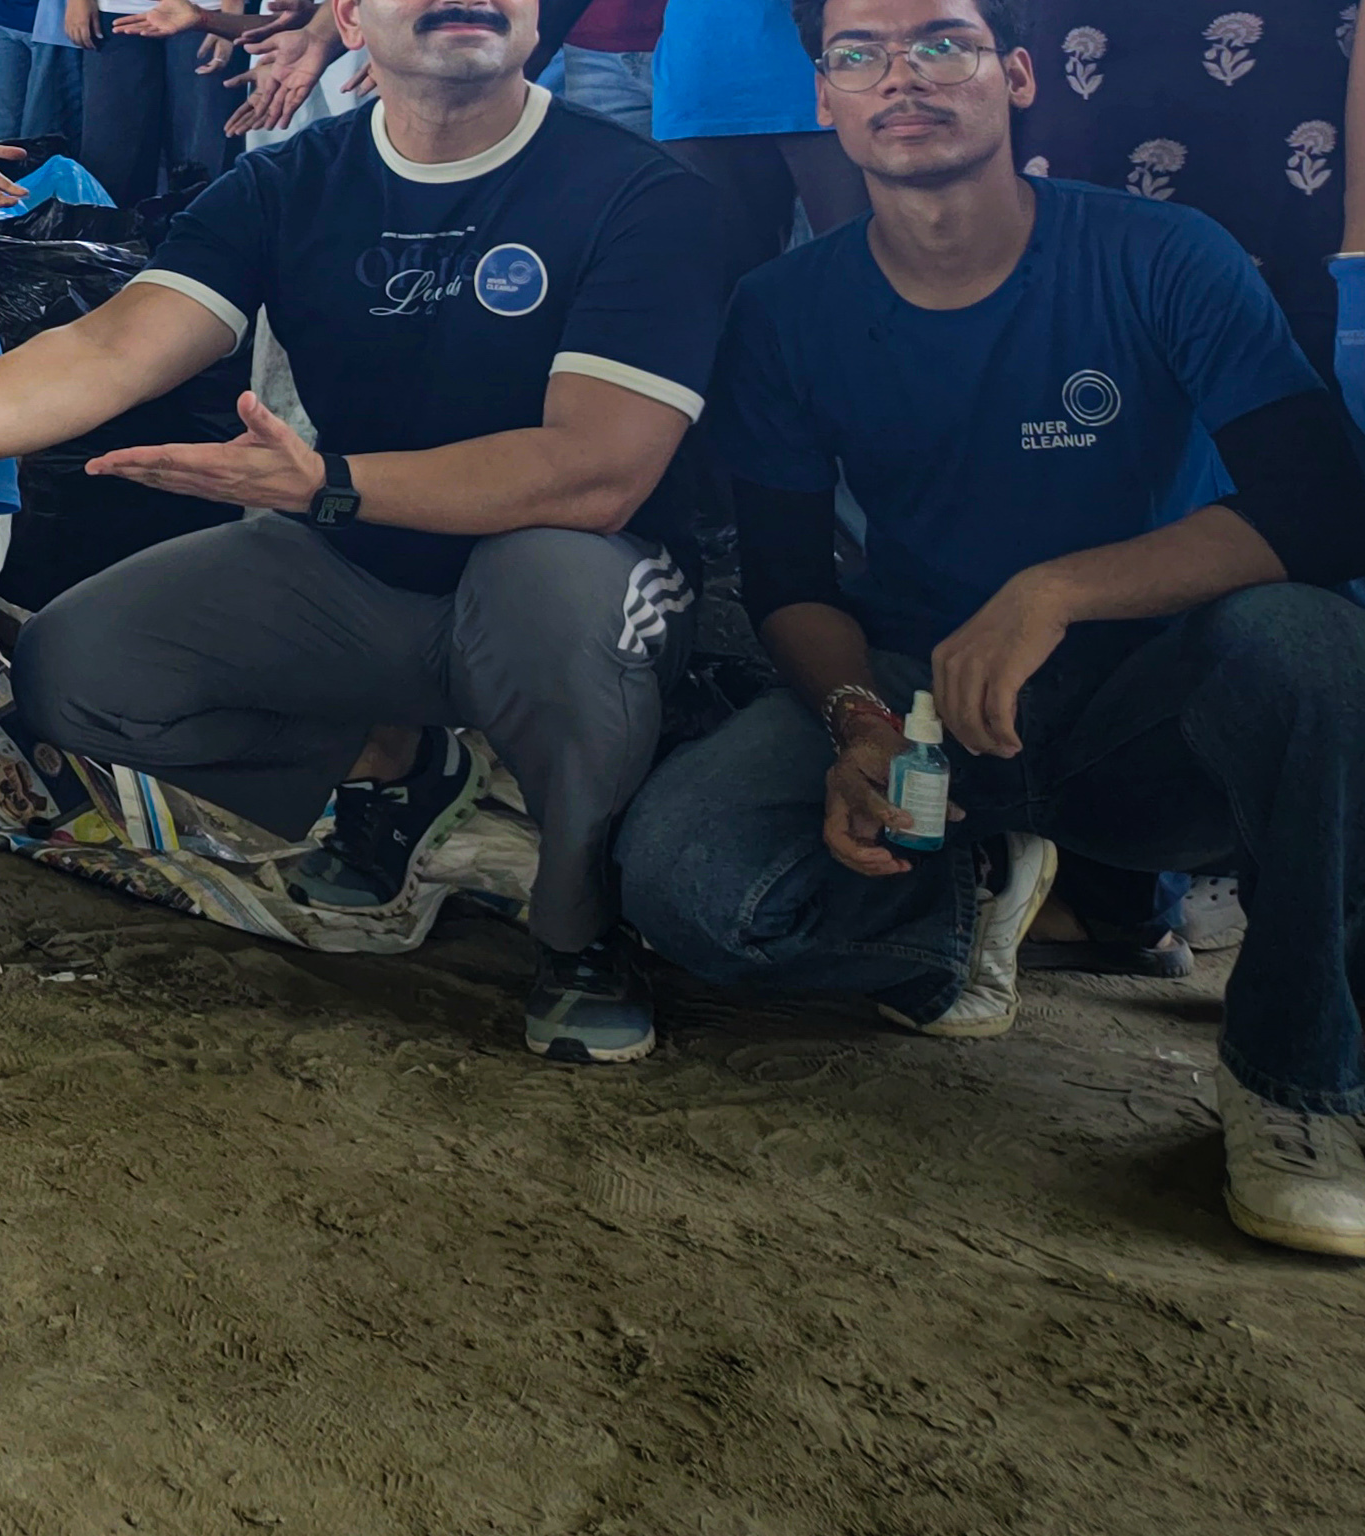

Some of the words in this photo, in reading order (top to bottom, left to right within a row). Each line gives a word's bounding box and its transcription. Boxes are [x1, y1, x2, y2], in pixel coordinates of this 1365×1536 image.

[369, 269, 462, 316] Leeds
[485, 283, 519, 293] CLEANUP
[1020, 420, 1068, 436] RIVER
[1021, 433, 1097, 449] CLEANUP
